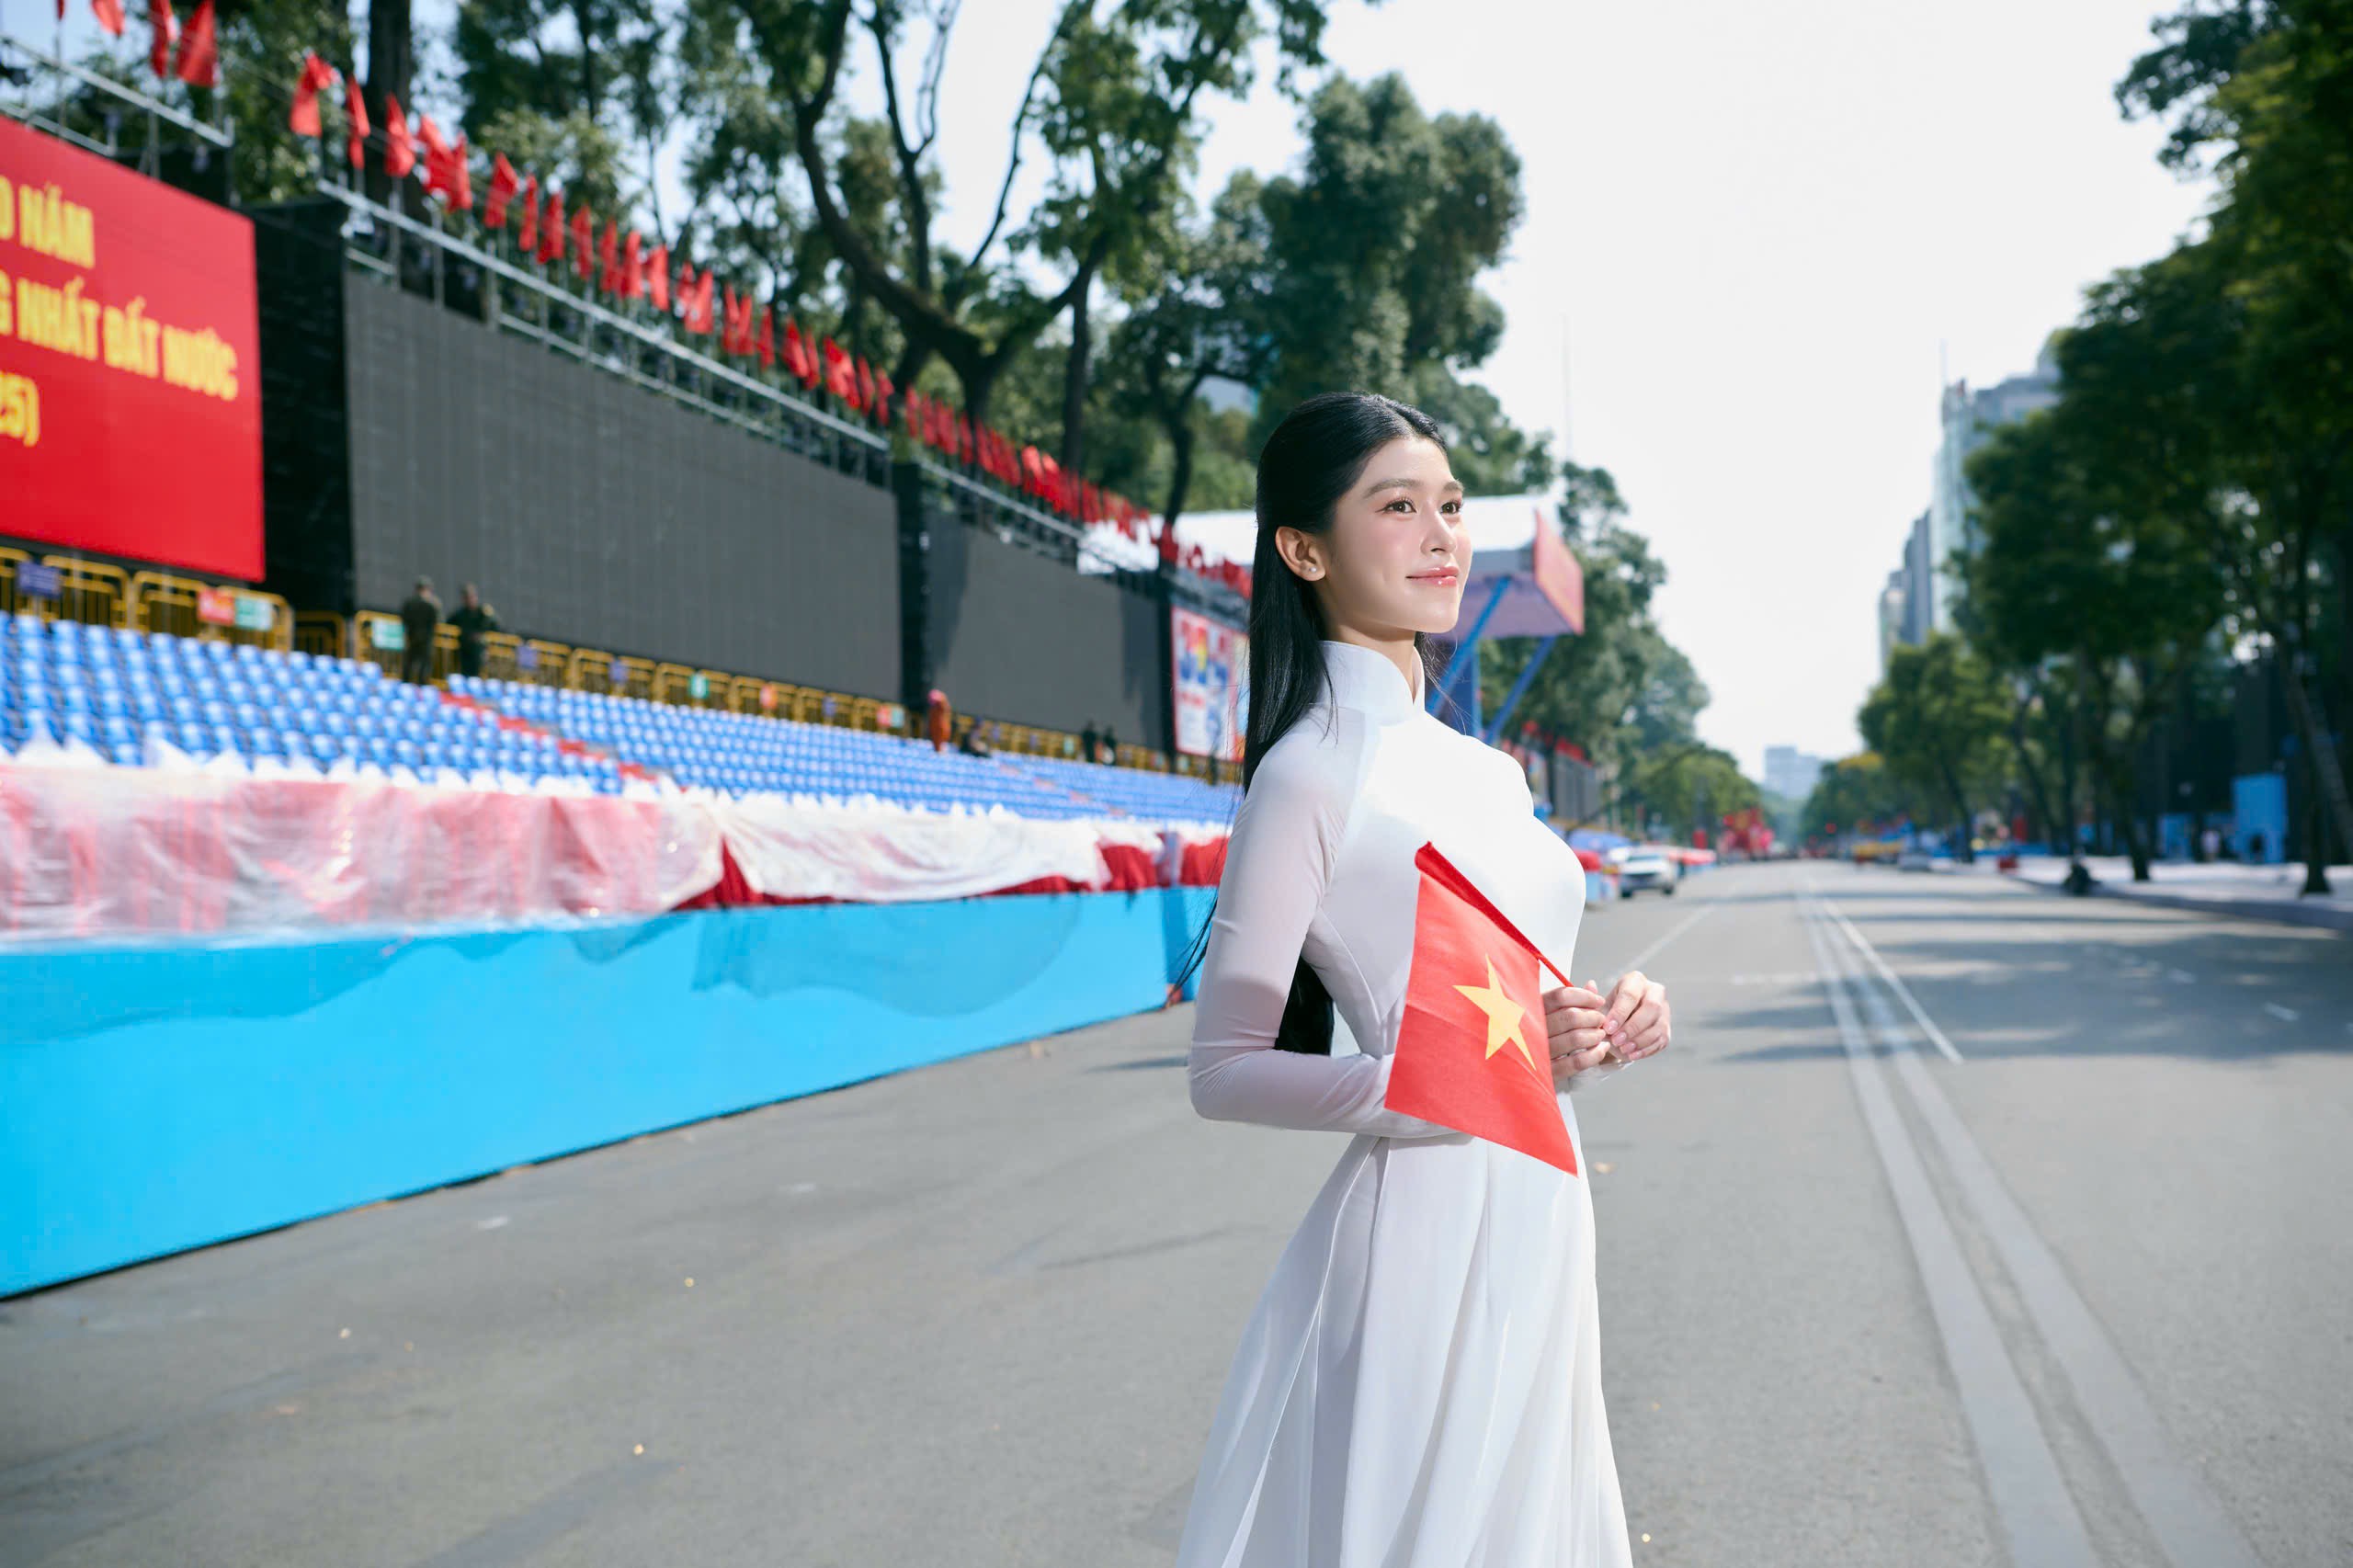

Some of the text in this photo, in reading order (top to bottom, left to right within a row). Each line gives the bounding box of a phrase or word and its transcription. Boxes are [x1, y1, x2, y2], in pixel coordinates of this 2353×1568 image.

[17, 277, 100, 359] NHẤT
[104, 296, 160, 378] ĐẤT
[163, 326, 237, 401] NƯỚC
